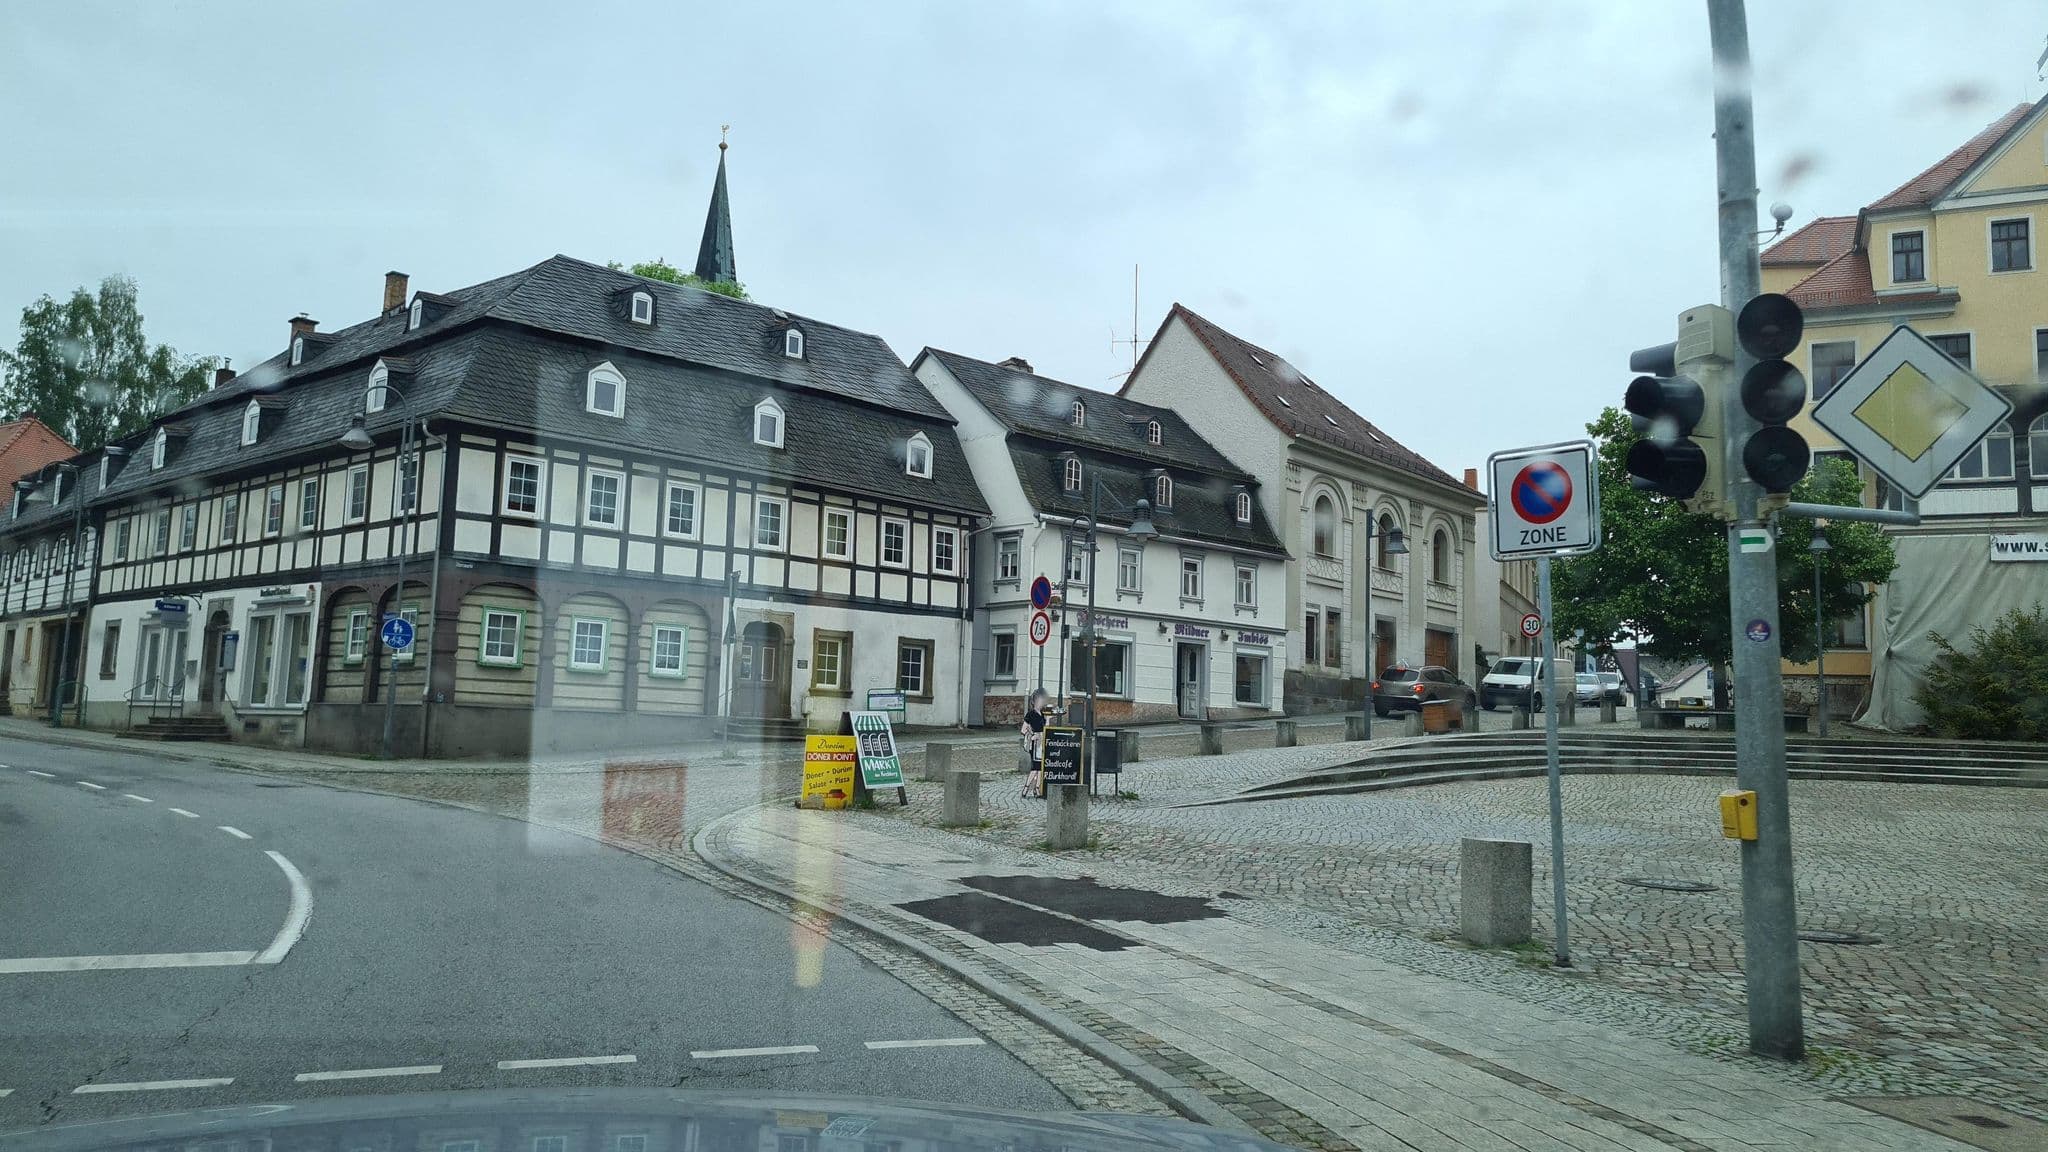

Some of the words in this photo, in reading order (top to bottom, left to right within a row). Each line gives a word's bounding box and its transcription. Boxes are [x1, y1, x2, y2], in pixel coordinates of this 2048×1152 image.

[1519, 526, 1567, 546] ZONE
[1525, 619, 1539, 631] 30
[833, 752, 853, 761] POINT
[1049, 749, 1061, 757] und
[864, 758, 896, 771] MARKT
[834, 776, 850, 785] Pizza
